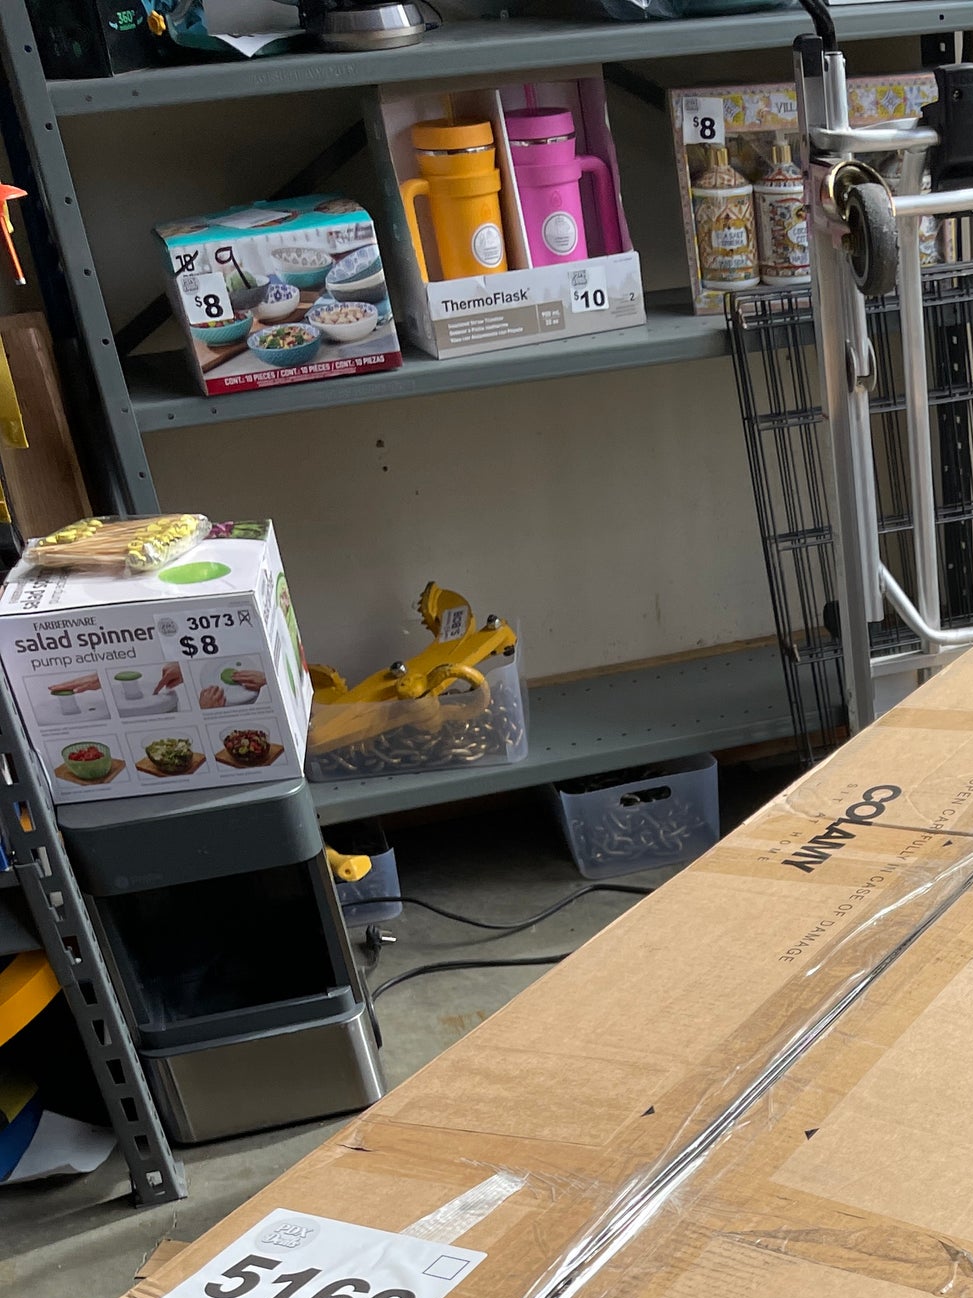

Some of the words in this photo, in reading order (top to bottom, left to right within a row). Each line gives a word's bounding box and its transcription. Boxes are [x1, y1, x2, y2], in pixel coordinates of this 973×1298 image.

[776, 102, 798, 115] VILL
[693, 116, 716, 140] $8
[195, 293, 224, 318] $8
[442, 289, 529, 312] ThermoFlask
[574, 289, 606, 310] $10
[33, 616, 97, 631] FARBERWARE
[186, 613, 235, 631] 3073
[15, 629, 75, 653] salad
[78, 625, 156, 648] spinner
[179, 635, 219, 657] $8
[31, 653, 73, 670] pump
[76, 647, 137, 664] activated
[781, 785, 902, 873] COLAMY
[900, 809, 956, 861] CARFULLY
[881, 863, 899, 875] IN
[850, 876, 884, 901] CASE
[835, 904, 852, 917] OF
[779, 920, 835, 962] DAMAGE
[260, 1231, 302, 1250] Deals
[277, 1222, 315, 1240] PDX
